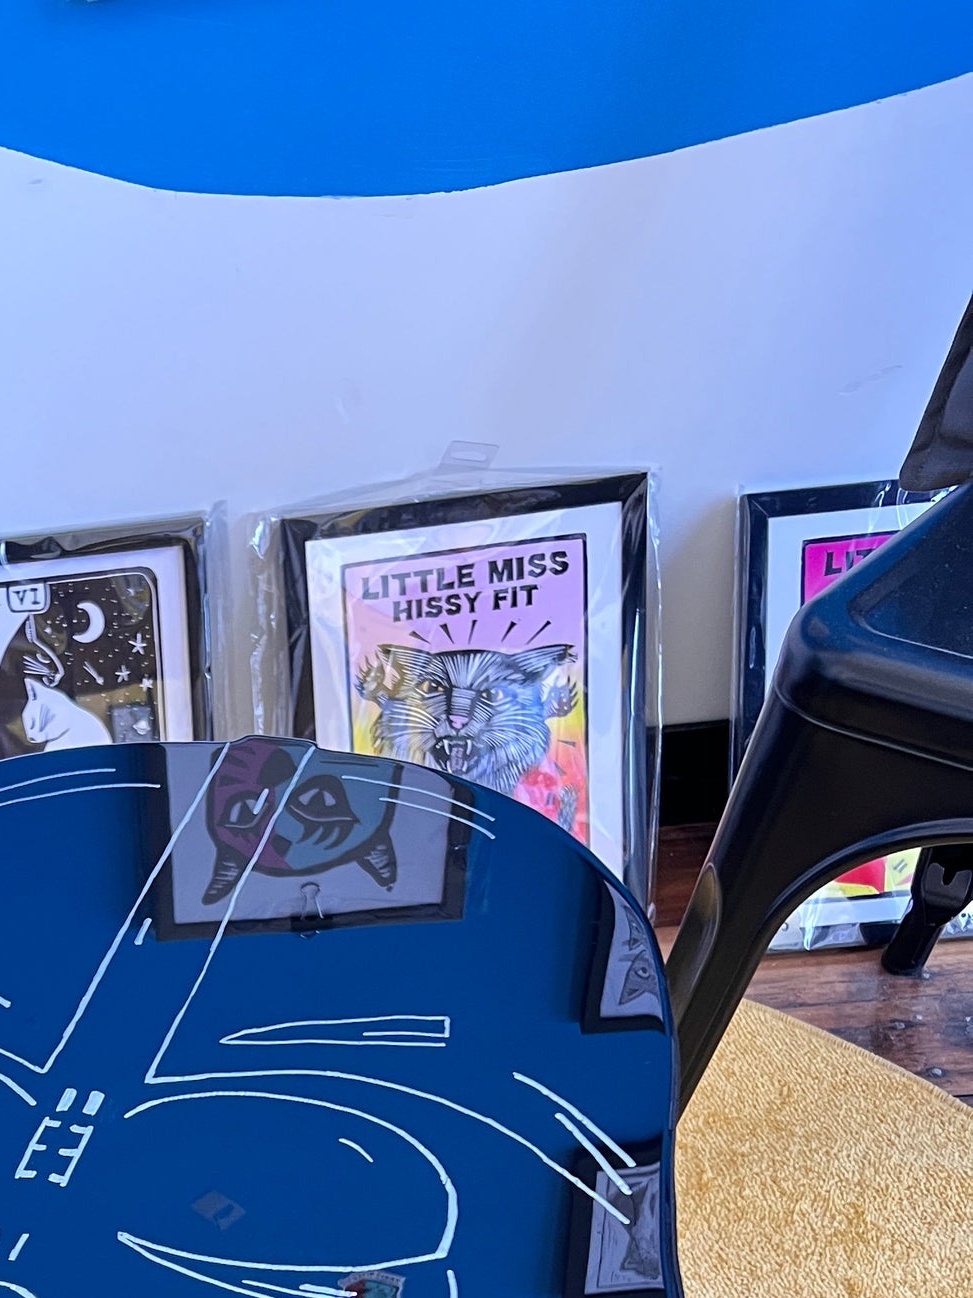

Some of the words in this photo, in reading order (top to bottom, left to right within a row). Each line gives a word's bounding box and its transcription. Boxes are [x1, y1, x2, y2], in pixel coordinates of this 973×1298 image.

[361, 562, 476, 600] LITTLE
[488, 550, 570, 585] MISS
[12, 587, 41, 606] VI
[392, 591, 482, 623] HISSY
[492, 584, 539, 611] FIT
